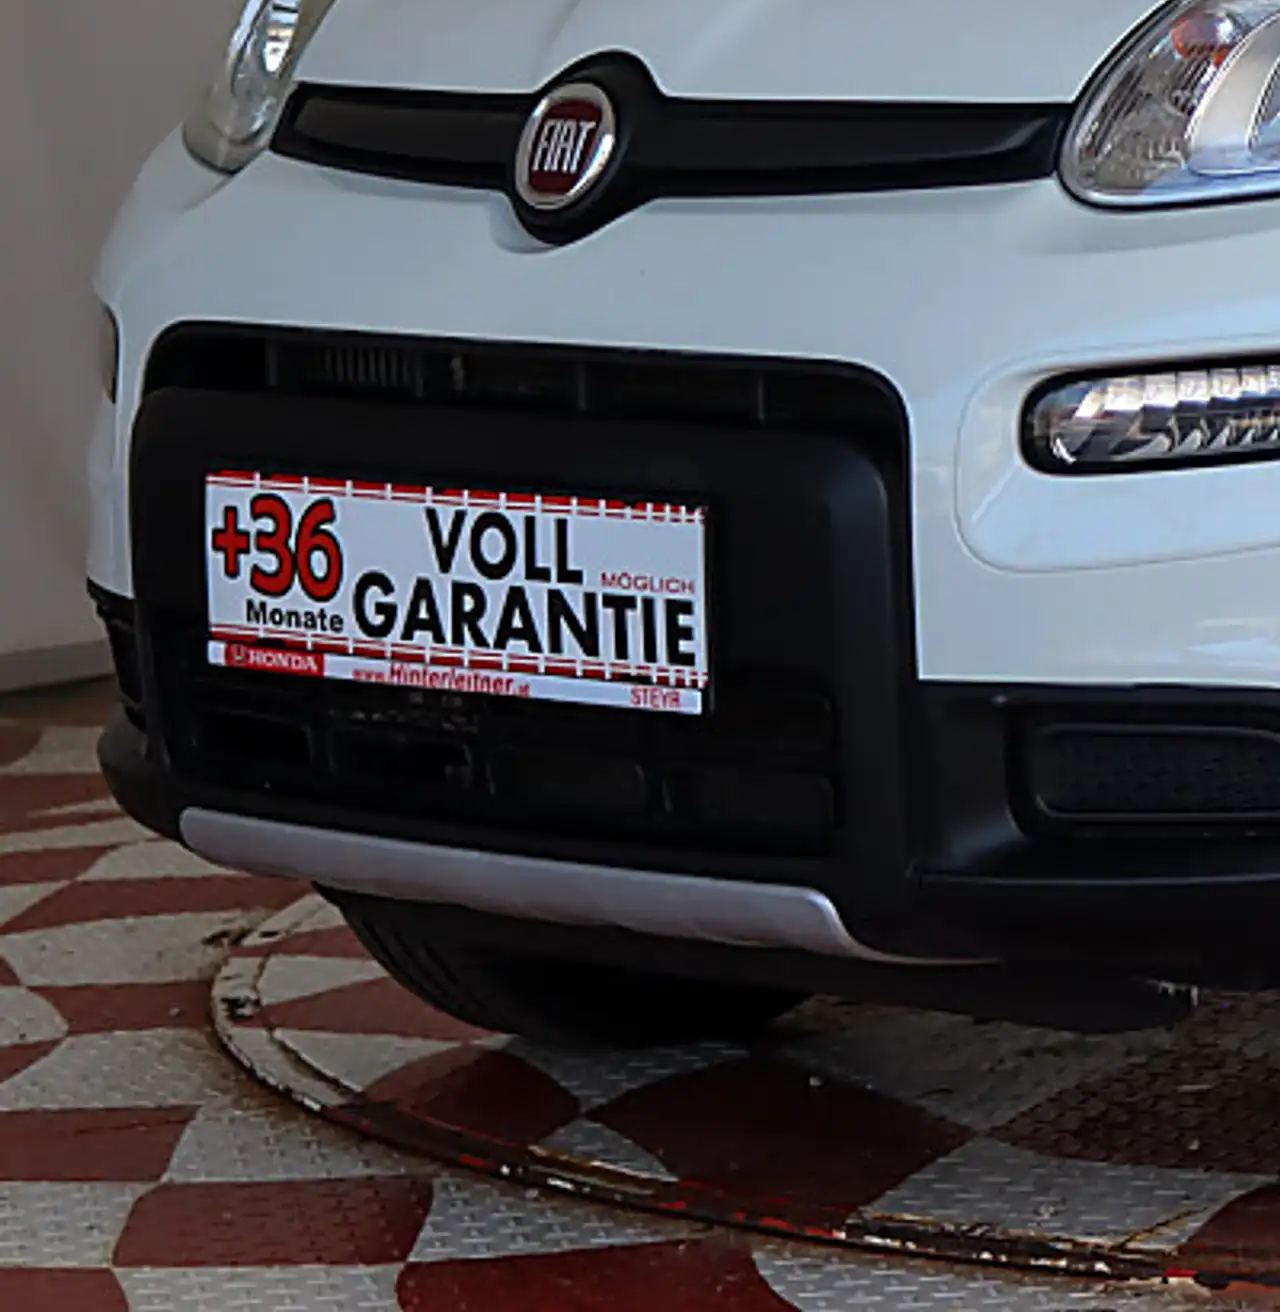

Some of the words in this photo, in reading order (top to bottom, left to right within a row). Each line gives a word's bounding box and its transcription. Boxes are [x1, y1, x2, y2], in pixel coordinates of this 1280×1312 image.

[532, 119, 596, 173] FIAT
[212, 493, 343, 602] +36
[425, 508, 583, 585] VOLL
[246, 599, 344, 633] Monate
[353, 571, 696, 666] GARANTIE
[248, 648, 318, 672] HONDA
[630, 688, 681, 709] STEYR
